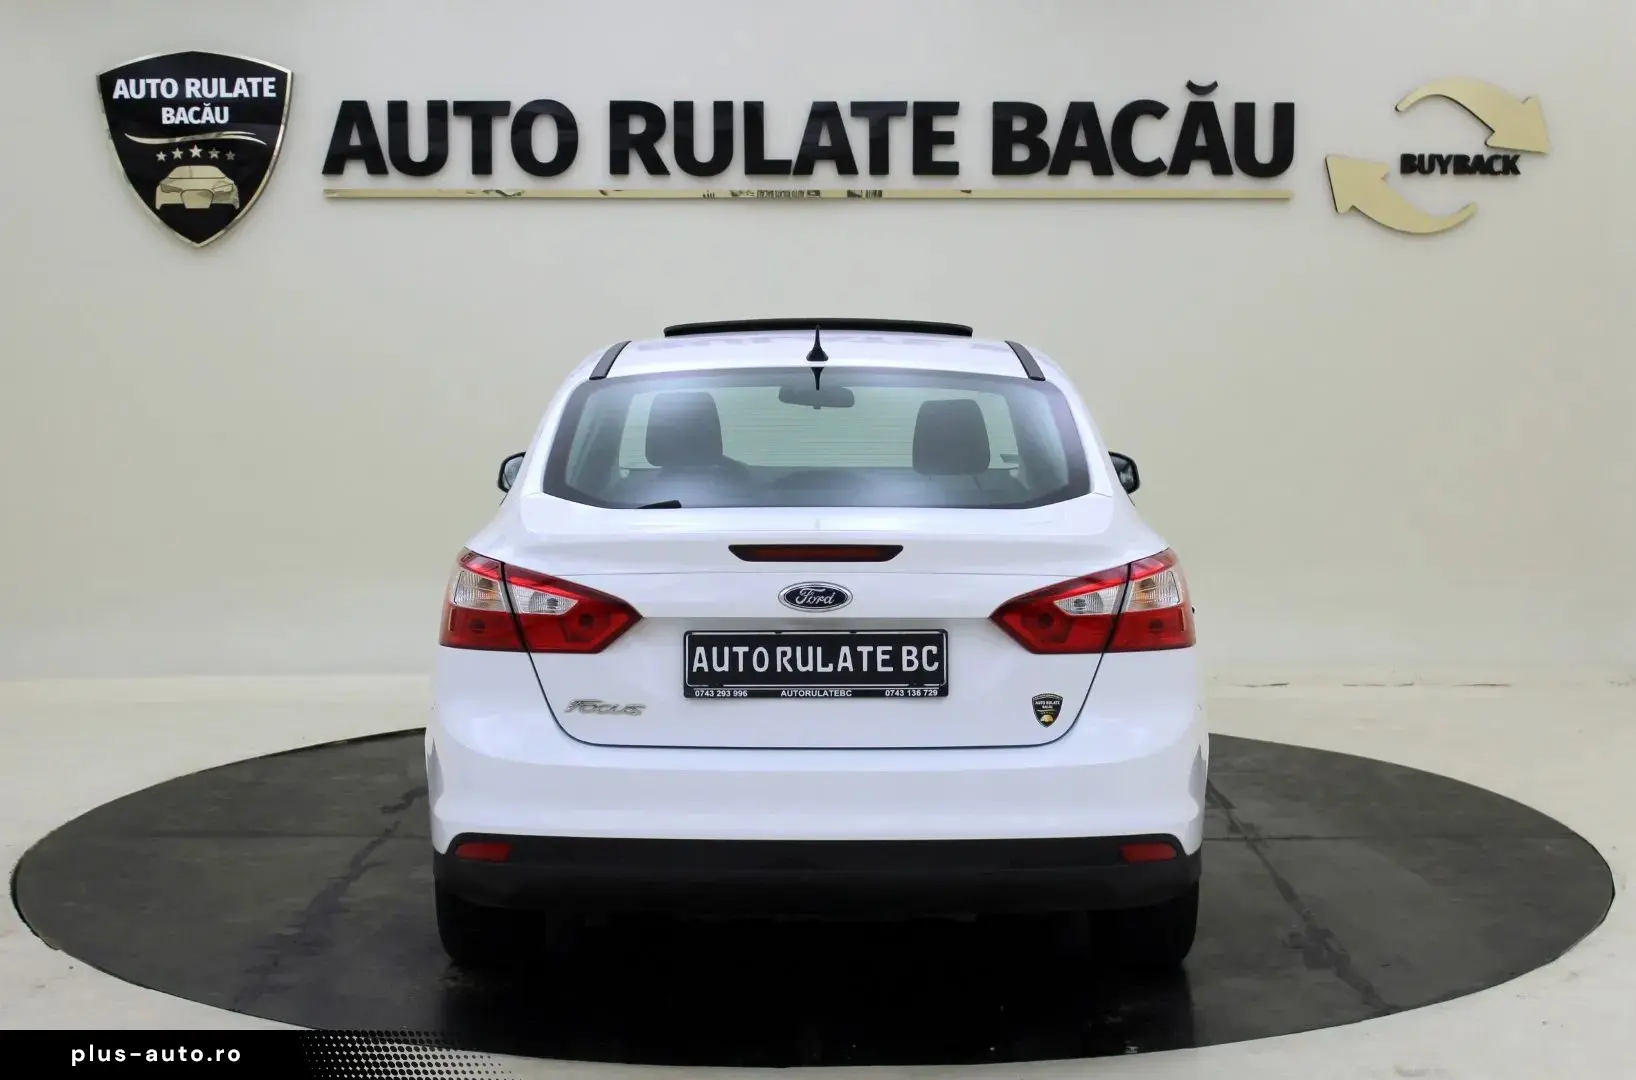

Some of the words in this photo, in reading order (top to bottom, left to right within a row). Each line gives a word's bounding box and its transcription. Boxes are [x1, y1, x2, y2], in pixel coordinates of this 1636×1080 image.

[112, 78, 179, 99] AUTO
[185, 77, 277, 98] RULATE
[161, 102, 230, 125] BACĂU
[322, 98, 579, 178] AUTO
[609, 100, 961, 178] RULATE
[991, 80, 1296, 179] BACĂU
[1400, 153, 1522, 177] BUYBACK
[795, 587, 836, 605] Ford
[692, 645, 771, 673] AUTO
[776, 645, 895, 673] RULATE
[901, 645, 940, 673] BC
[694, 689, 715, 697] 0743
[716, 689, 731, 697] 293
[733, 689, 748, 697] 996
[780, 688, 853, 698] AUTORULATEBC
[884, 689, 905, 697] 0743
[907, 689, 922, 697] 136
[923, 689, 939, 697] 729
